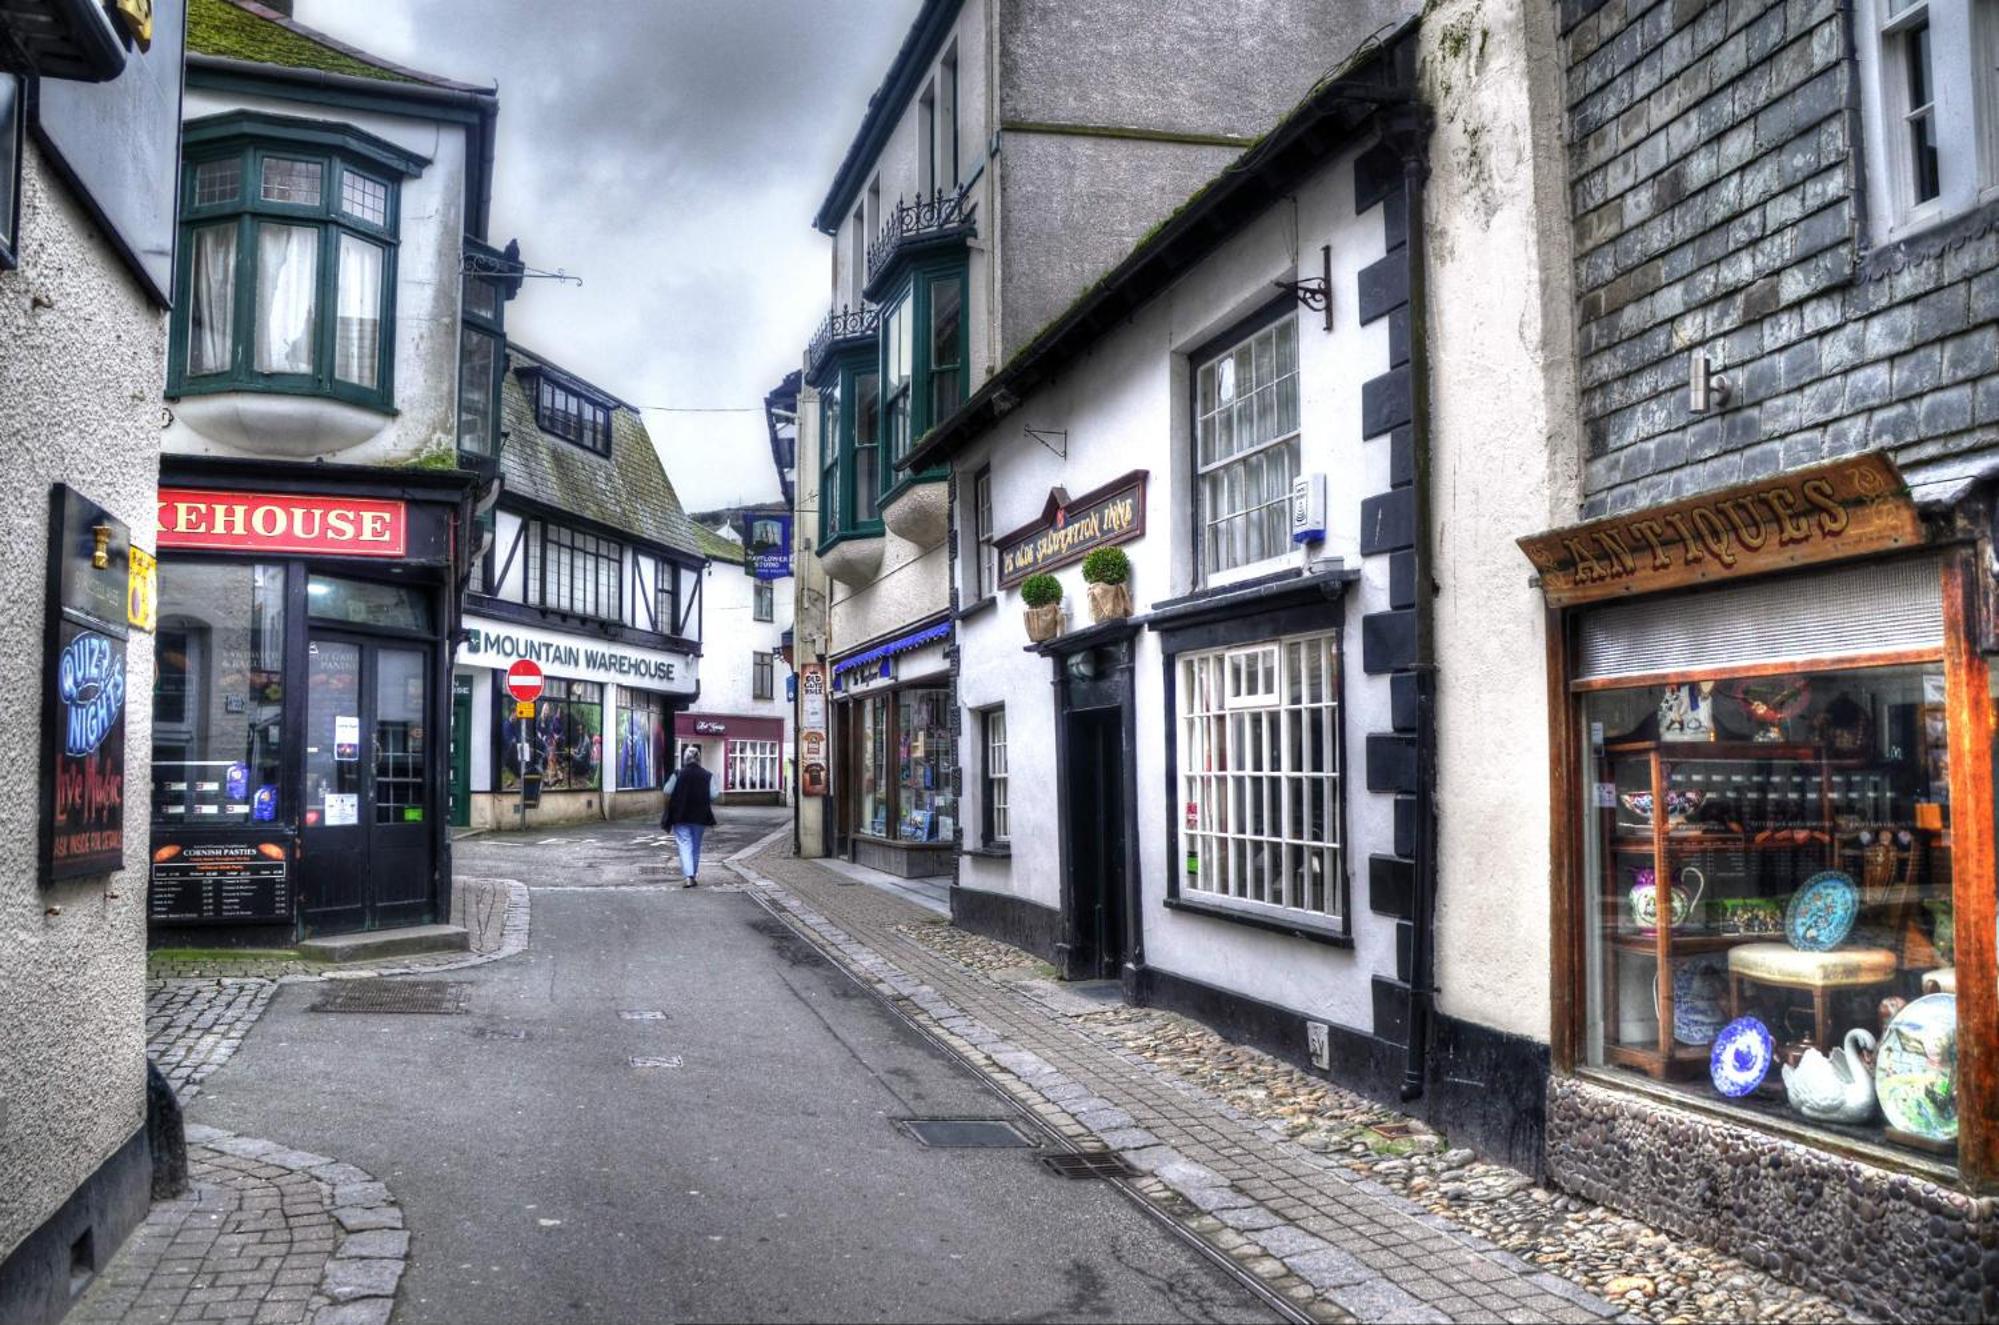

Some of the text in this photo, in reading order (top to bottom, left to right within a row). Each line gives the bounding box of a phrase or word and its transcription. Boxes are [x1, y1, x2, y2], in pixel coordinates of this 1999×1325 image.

[1103, 498, 1133, 531] INNE
[1563, 477, 1850, 586] ANTIQUES
[484, 632, 675, 681] MOUNTAIN WAREHOUSE
[69, 663, 124, 750] NIGHTS
[56, 754, 121, 826] Live Music
[183, 847, 257, 856] CORNISH PASTIES
